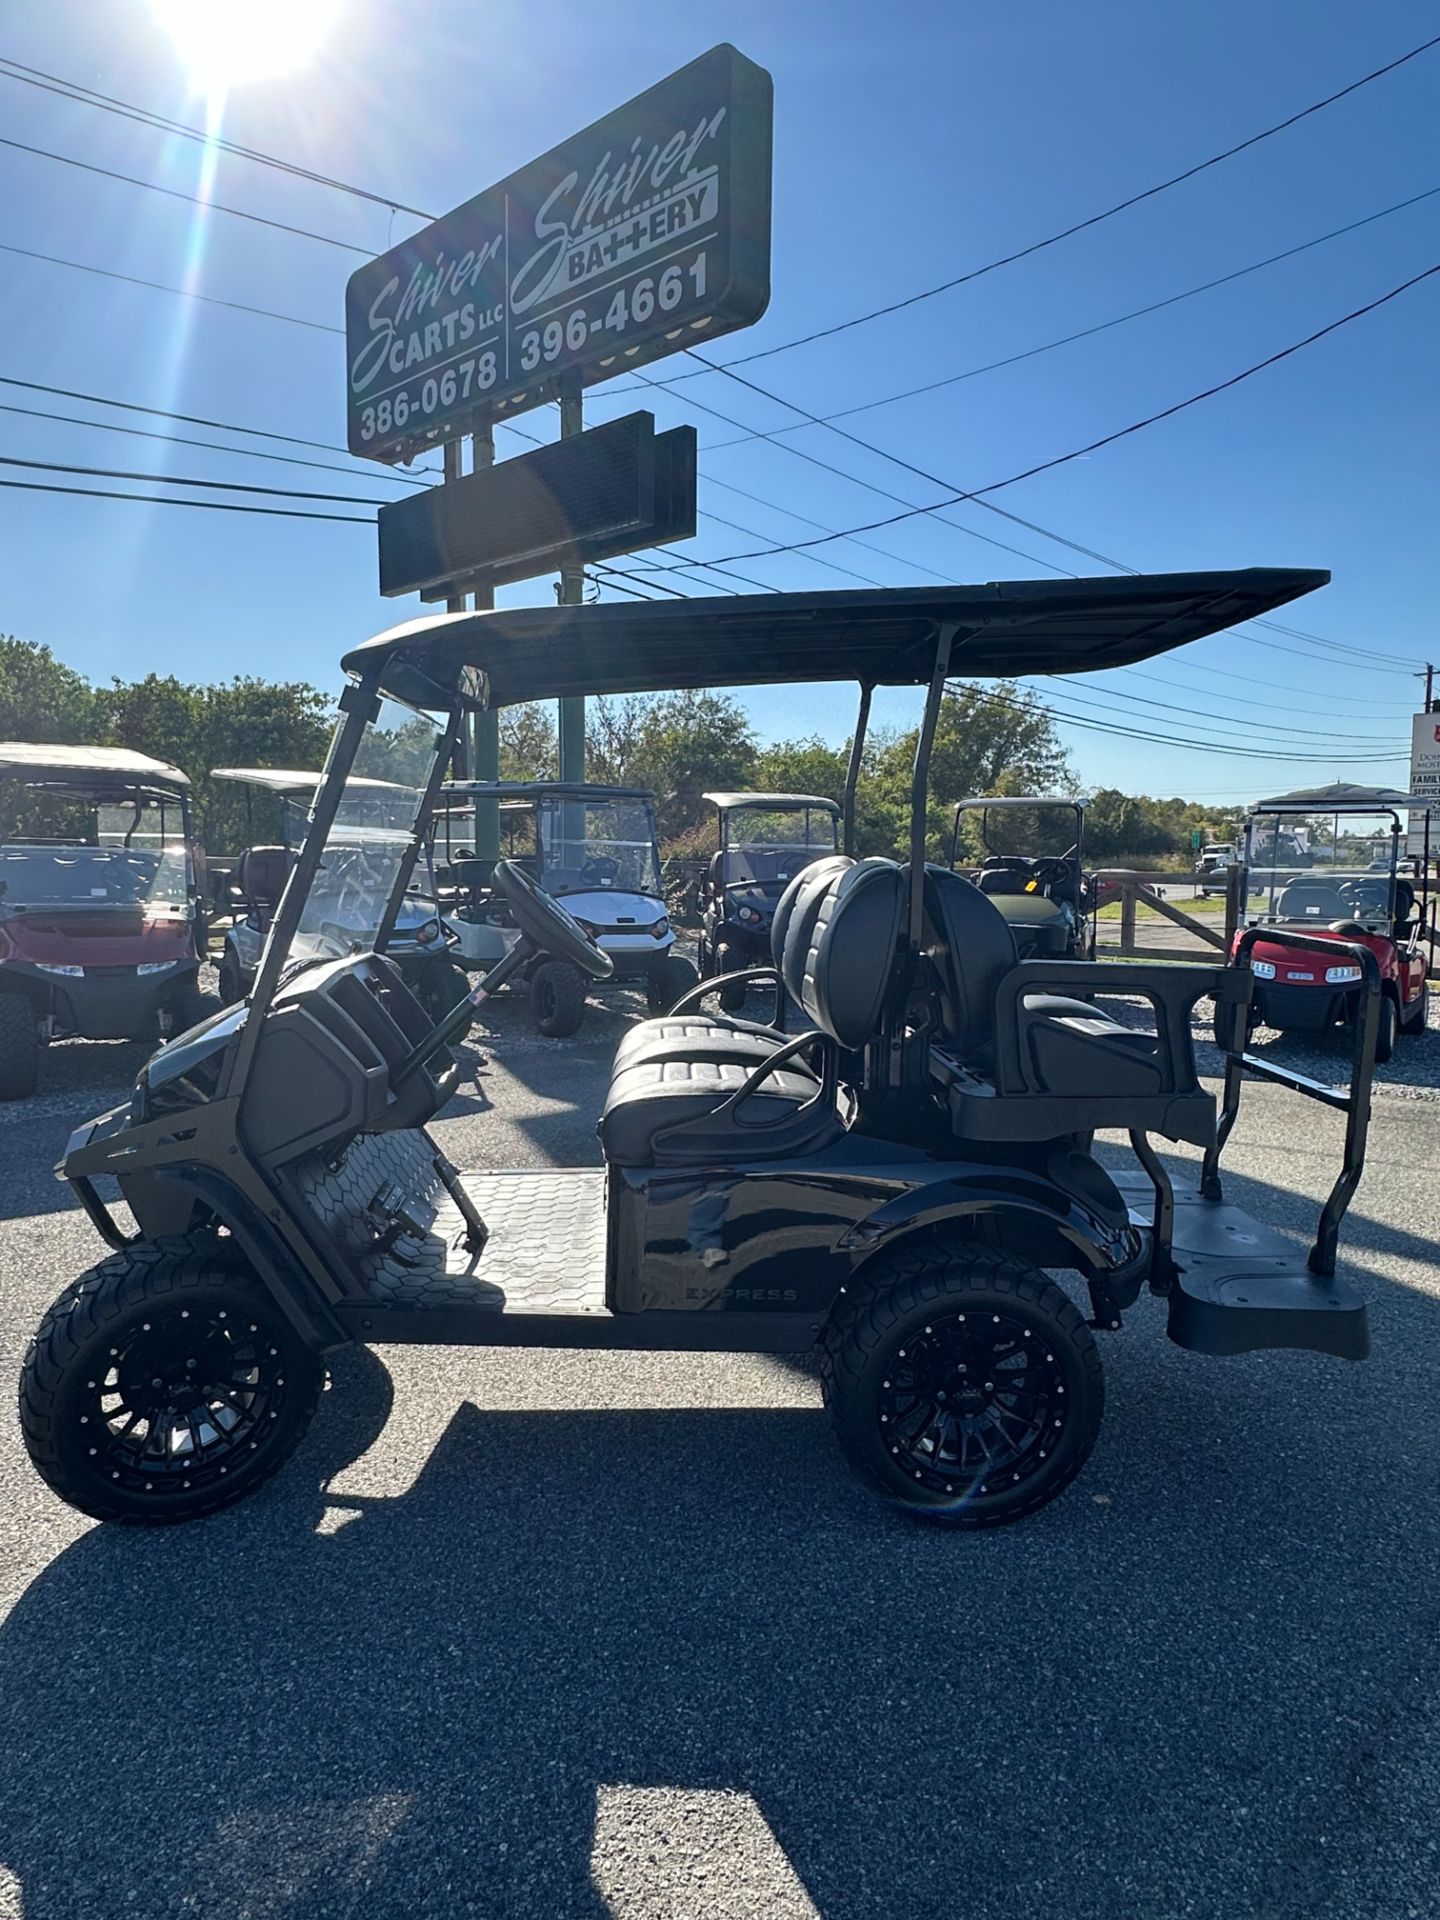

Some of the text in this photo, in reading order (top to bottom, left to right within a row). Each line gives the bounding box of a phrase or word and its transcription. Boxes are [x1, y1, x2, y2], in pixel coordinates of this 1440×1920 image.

[508, 106, 726, 315] Shiver
[351, 234, 503, 393] Shiver
[389, 303, 504, 373] CARTS LLC
[520, 251, 706, 371] 396-4661
[360, 351, 497, 441] 386-0678
[1412, 775, 1440, 784] FAMIL
[1413, 788, 1440, 796] SERVIC
[686, 1287, 797, 1300] EXPRESS
